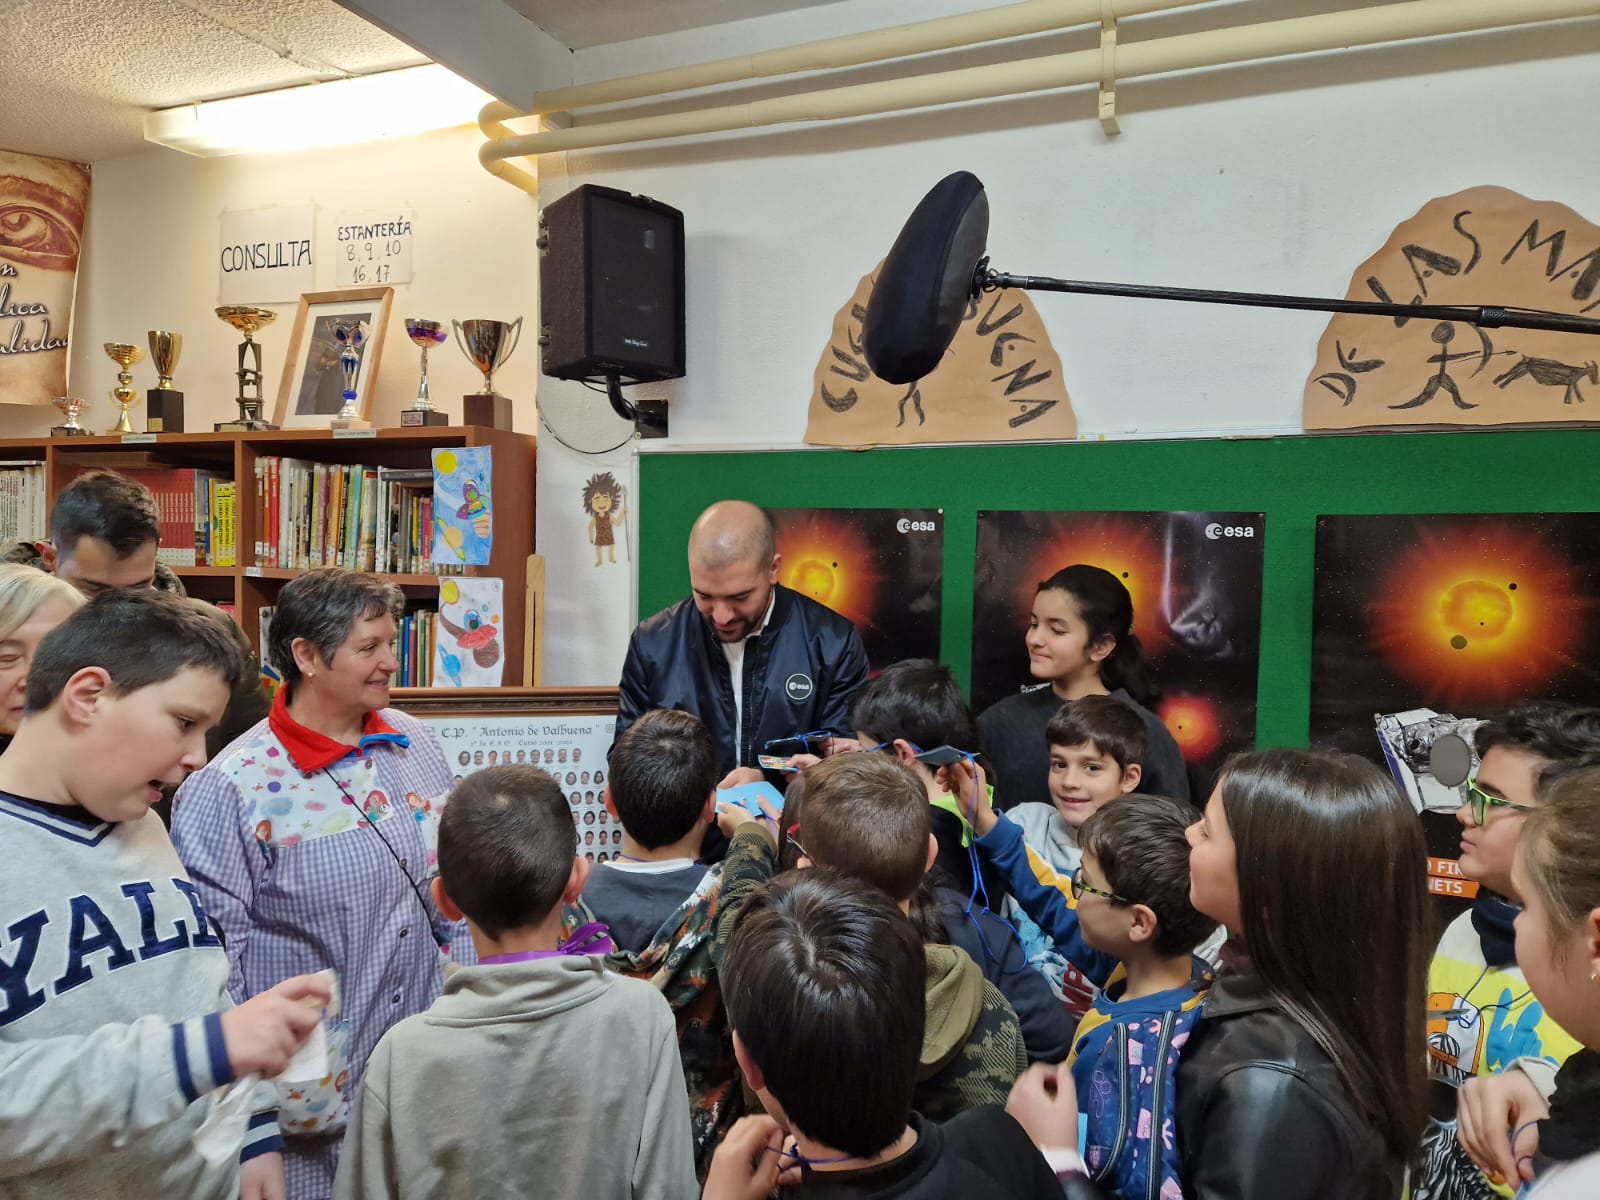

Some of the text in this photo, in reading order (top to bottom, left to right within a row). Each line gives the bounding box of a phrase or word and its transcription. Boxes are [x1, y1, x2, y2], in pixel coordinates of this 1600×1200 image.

[338, 216, 412, 242] ESTANTERÍA
[221, 239, 312, 273] CONSULTA
[384, 239, 402, 257] 10
[375, 265, 391, 283] 17
[1313, 340, 1385, 407] DE
[528, 726, 539, 737] de
